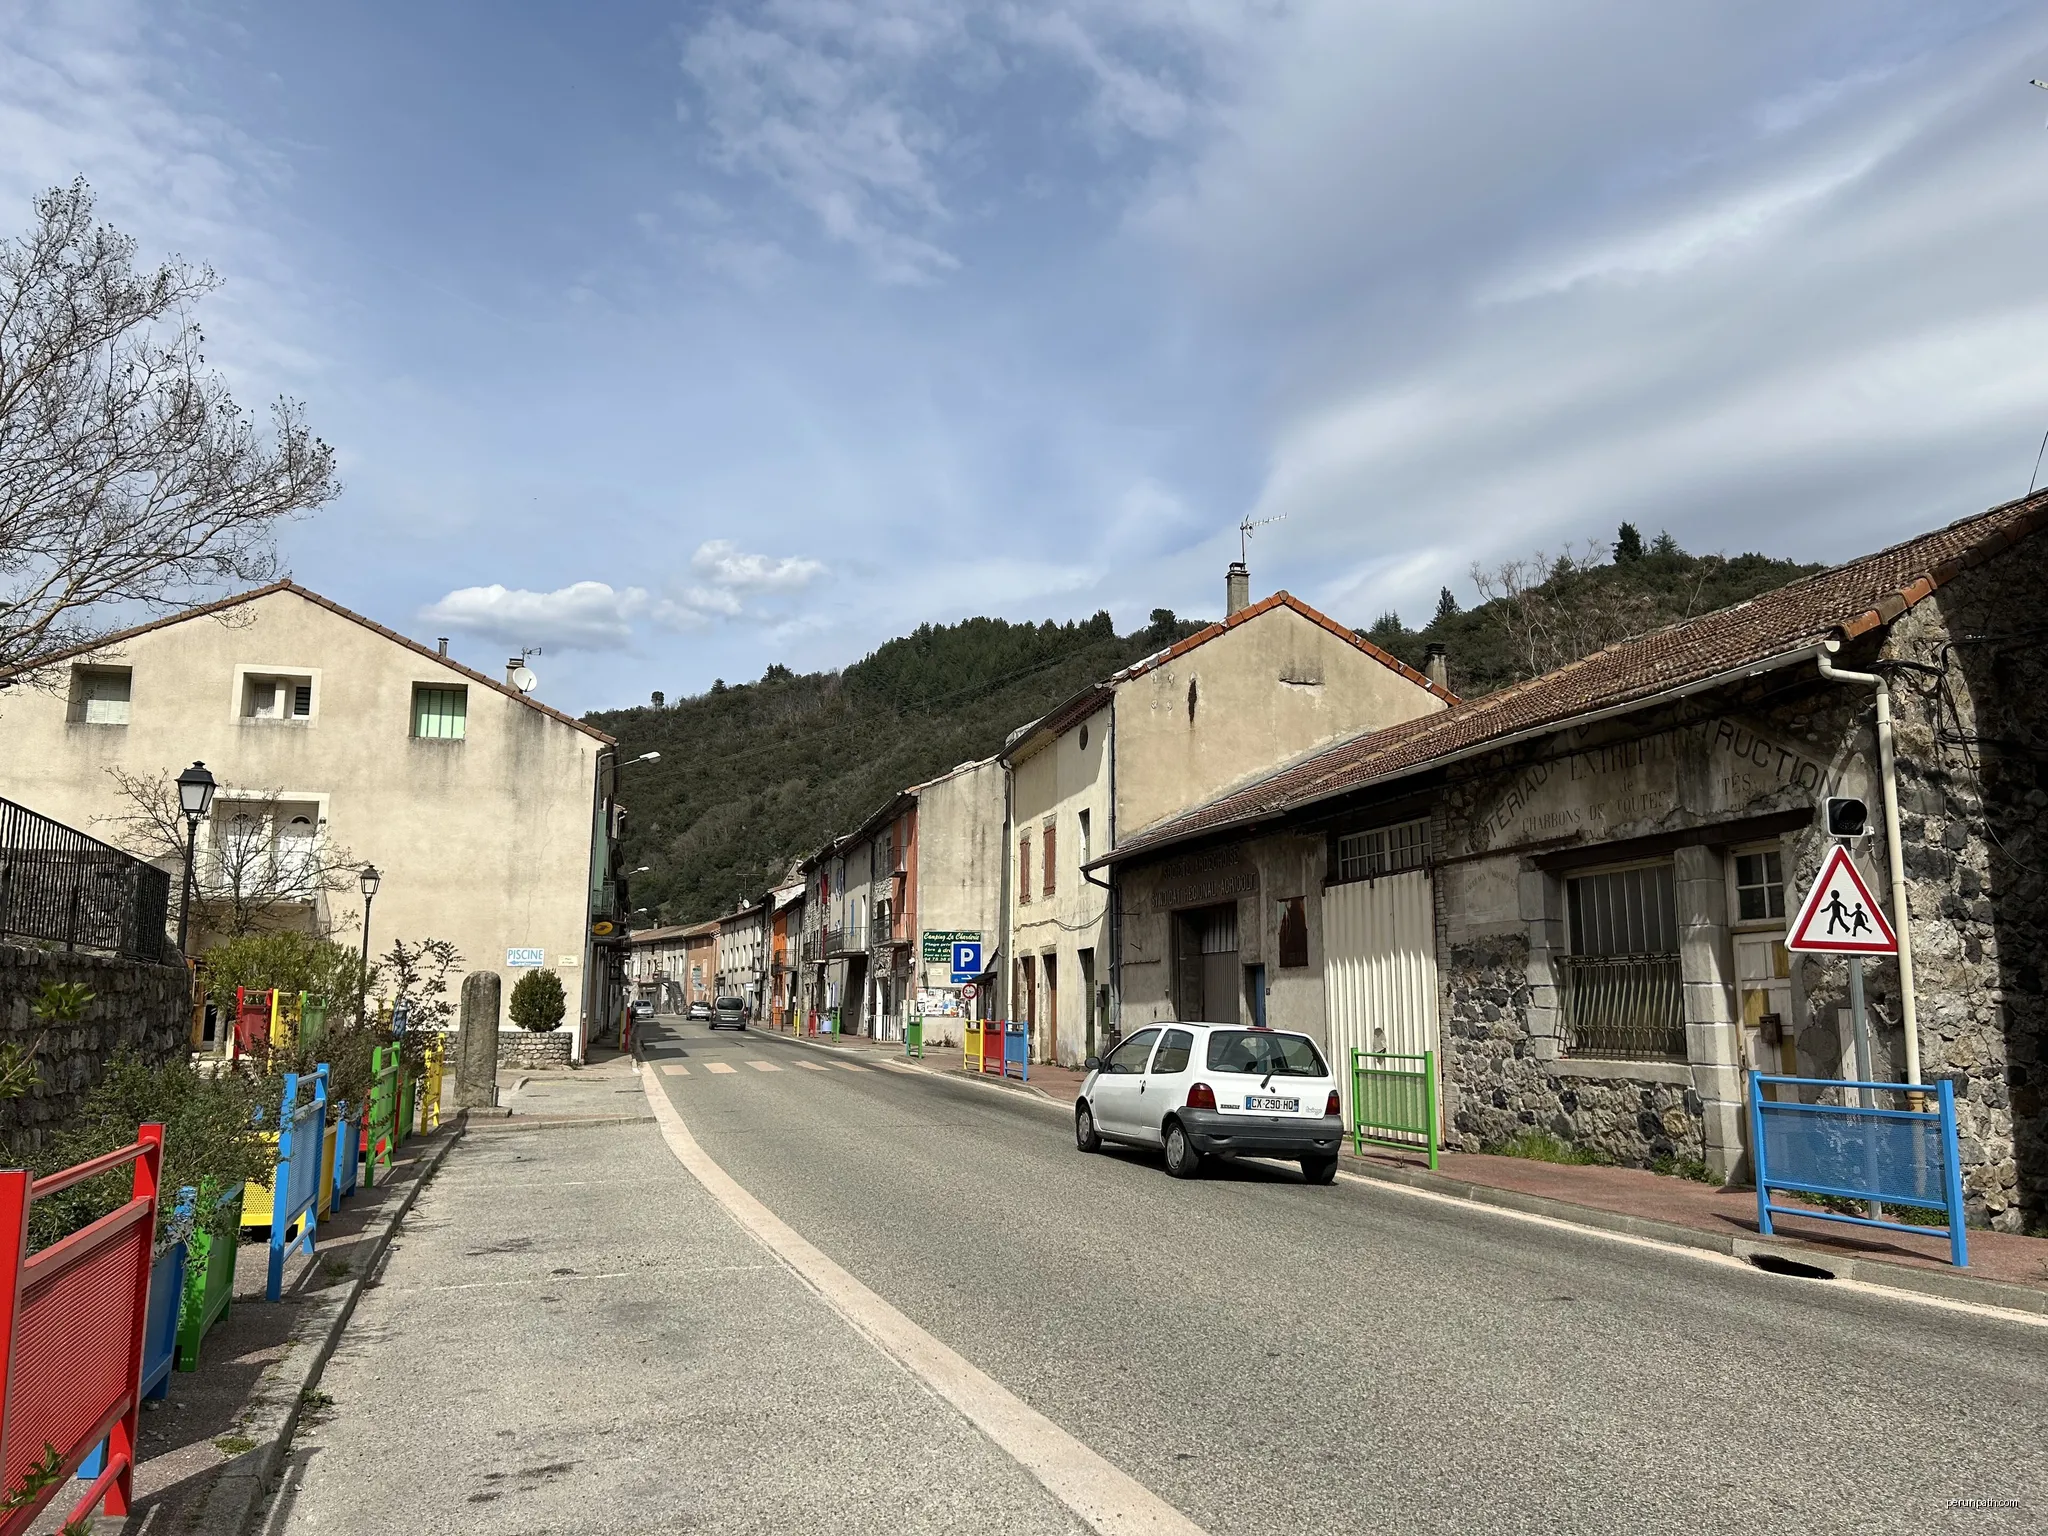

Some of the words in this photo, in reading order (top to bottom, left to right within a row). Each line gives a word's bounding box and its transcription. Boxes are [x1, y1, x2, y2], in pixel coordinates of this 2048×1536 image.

[1522, 807, 1581, 833] CHARBONS
[1589, 802, 1606, 821] DE
[1151, 888, 1182, 908] SYNDICAT
[923, 932, 946, 942] Camping
[507, 949, 543, 960] PISCINE
[960, 948, 974, 968] P
